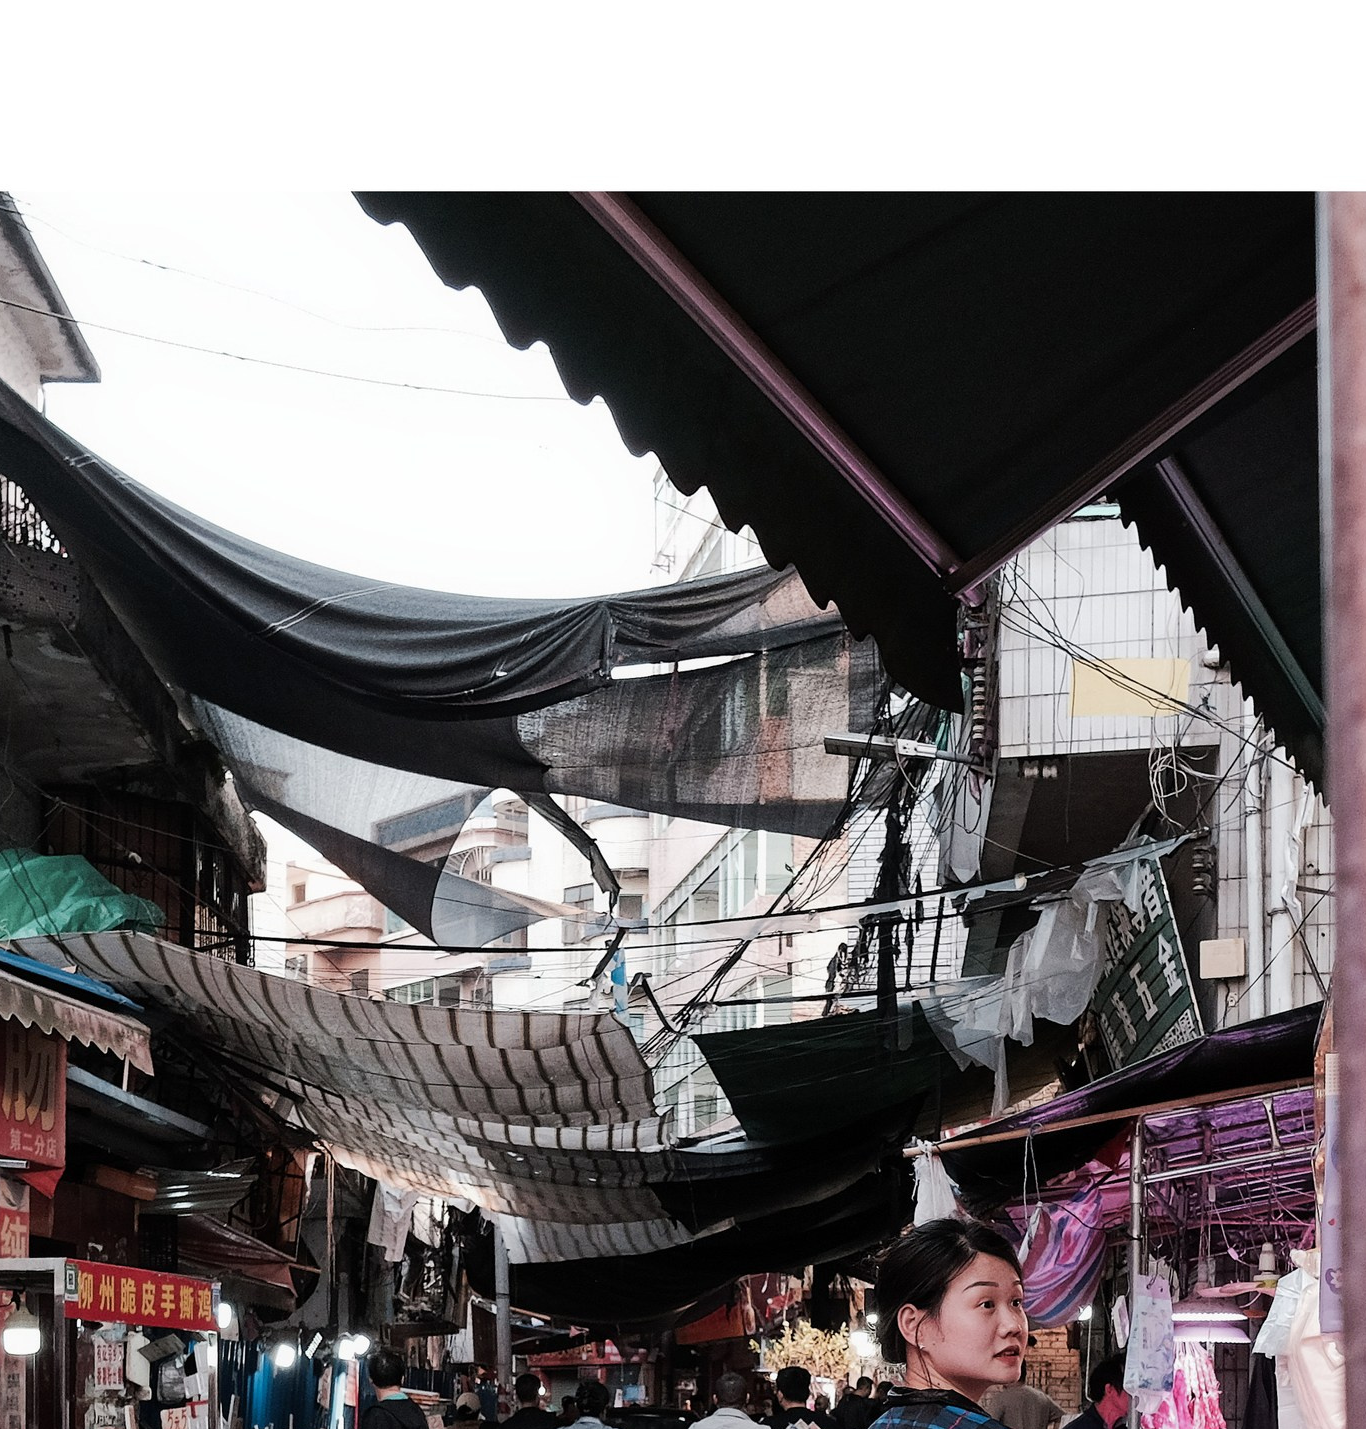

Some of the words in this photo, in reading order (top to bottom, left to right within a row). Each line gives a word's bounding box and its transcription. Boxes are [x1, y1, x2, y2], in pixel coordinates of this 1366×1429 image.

[9, 1127, 57, 1159] 第二分店
[78, 1270, 212, 1322] 柳州脆皮手撕鸡
